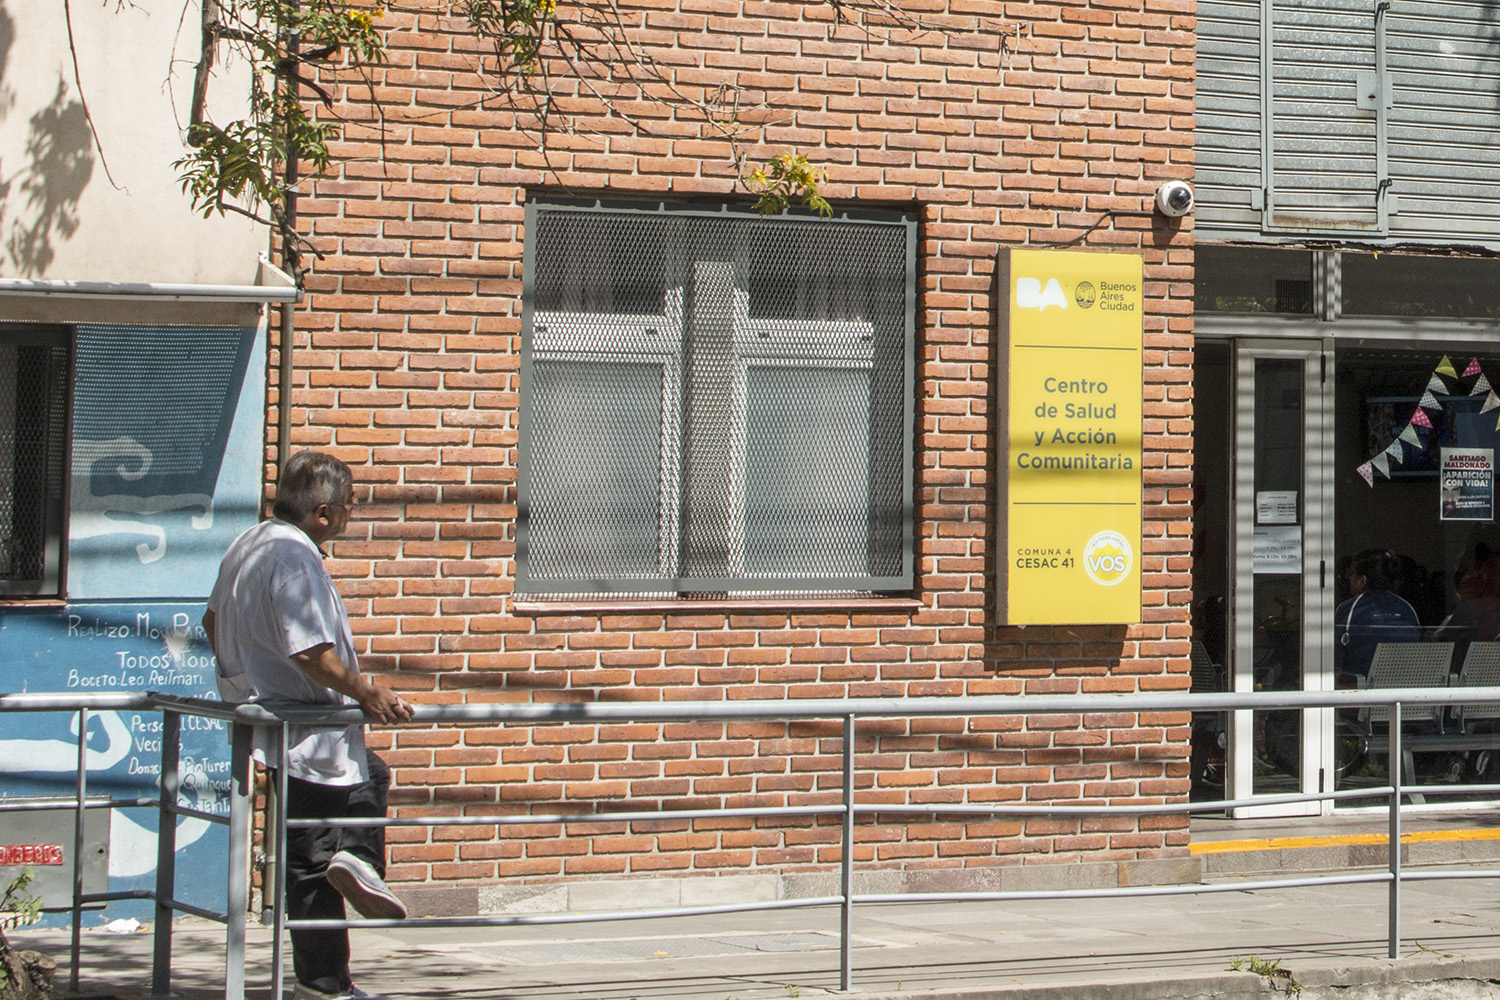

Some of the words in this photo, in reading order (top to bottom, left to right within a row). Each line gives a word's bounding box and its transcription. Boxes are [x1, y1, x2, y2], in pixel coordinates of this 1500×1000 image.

[1100, 281, 1136, 292] Buenos
[1100, 292, 1124, 301] Aires
[1100, 301, 1135, 311] Ciudad
[1044, 377, 1108, 394] Centro
[1034, 402, 1058, 418] de
[1064, 402, 1116, 419] Salud
[1034, 431, 1045, 447] y
[1051, 427, 1116, 445] Acción
[1017, 452, 1133, 470] Comunitaria
[1446, 479, 1463, 487] CON
[1465, 479, 1488, 487] VIDA!
[1017, 548, 1061, 556] COMUNA
[1016, 558, 1058, 569] CESAC
[1061, 558, 1074, 568] 41
[1088, 555, 1126, 573] VOS
[116, 651, 170, 670] TODOS
